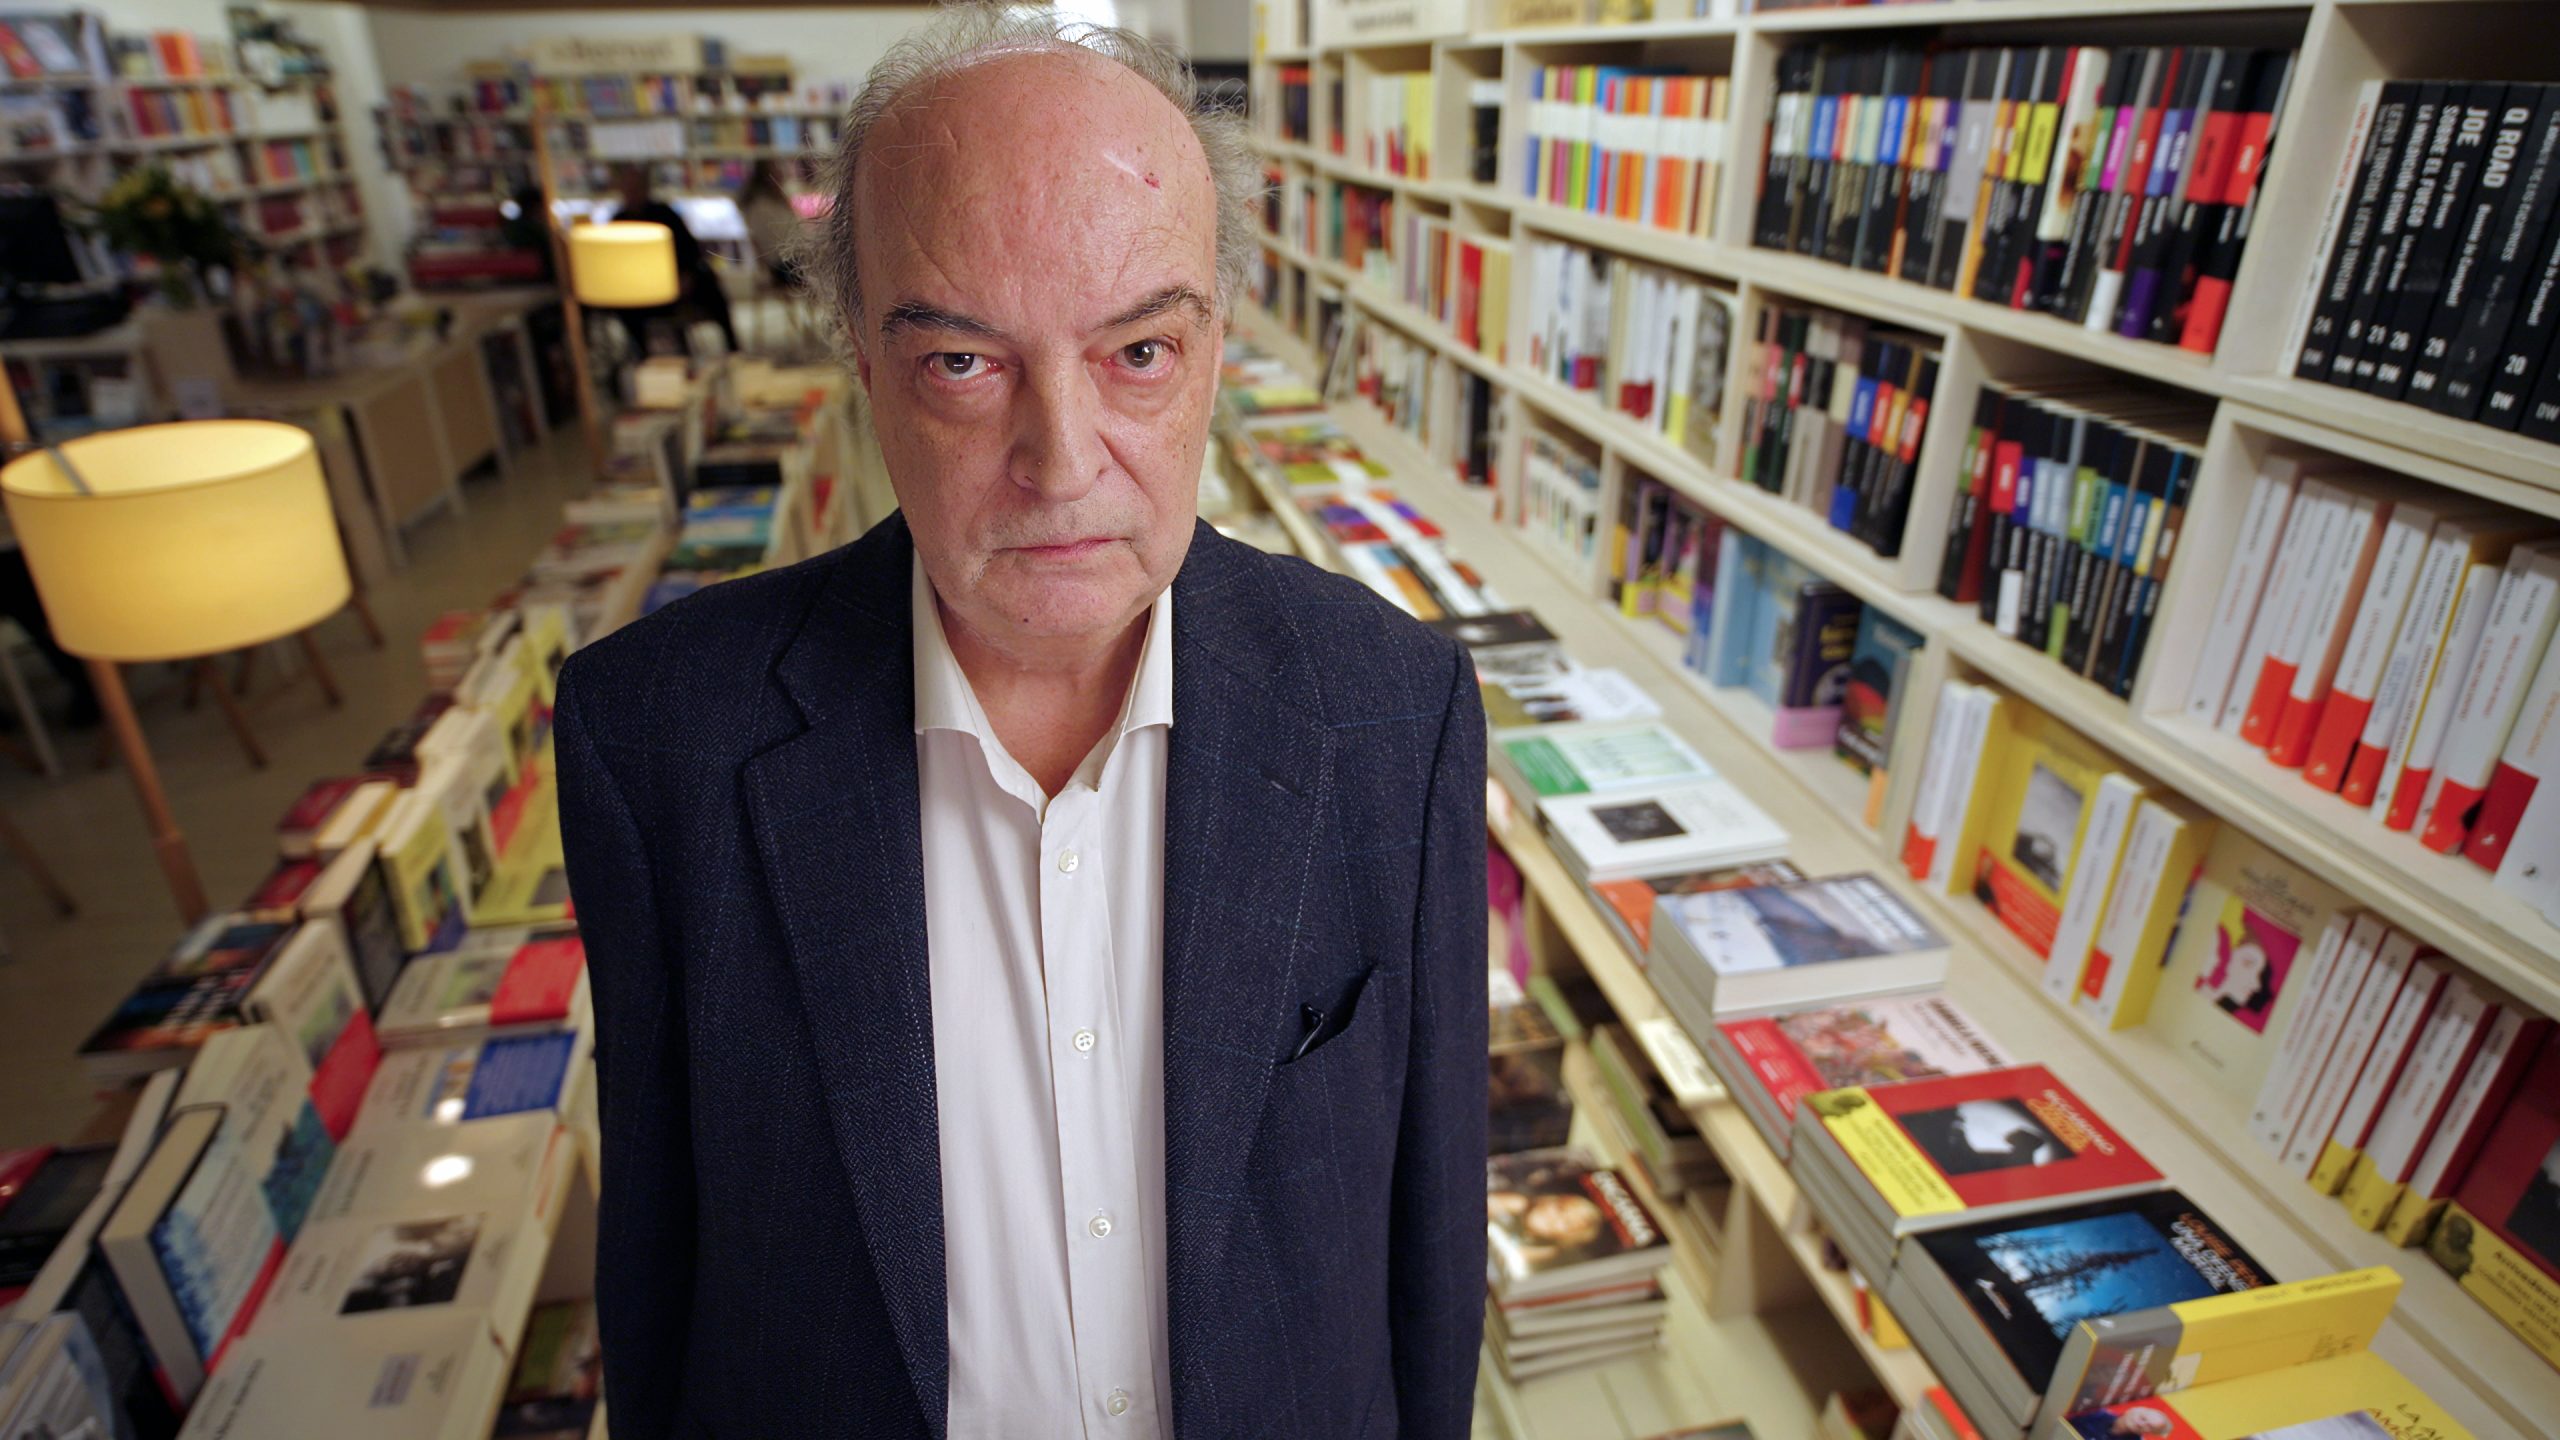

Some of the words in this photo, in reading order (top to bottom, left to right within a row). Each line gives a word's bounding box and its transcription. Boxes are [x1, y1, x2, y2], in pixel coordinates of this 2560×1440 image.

[2416, 104, 2435, 121] LA
[2503, 106, 2530, 125] Q
[2429, 104, 2461, 156] SOBRE
[2456, 106, 2489, 147] JOE
[2422, 156, 2444, 175] EL
[2482, 128, 2523, 188] ROAD
[2444, 160, 2467, 191] Larry
[2406, 177, 2437, 228] FUEGO
[2446, 255, 2473, 307] Campbell
[2313, 315, 2333, 336] 24
[2367, 323, 2387, 345] 21
[2332, 354, 2355, 374] DW
[2377, 362, 2401, 383] DW
[2504, 354, 2528, 376] 20
[2410, 369, 2437, 391] DW
[2489, 390, 2515, 411] DW
[2535, 401, 2560, 422] DW
[2170, 1220, 2206, 1249] UNA
